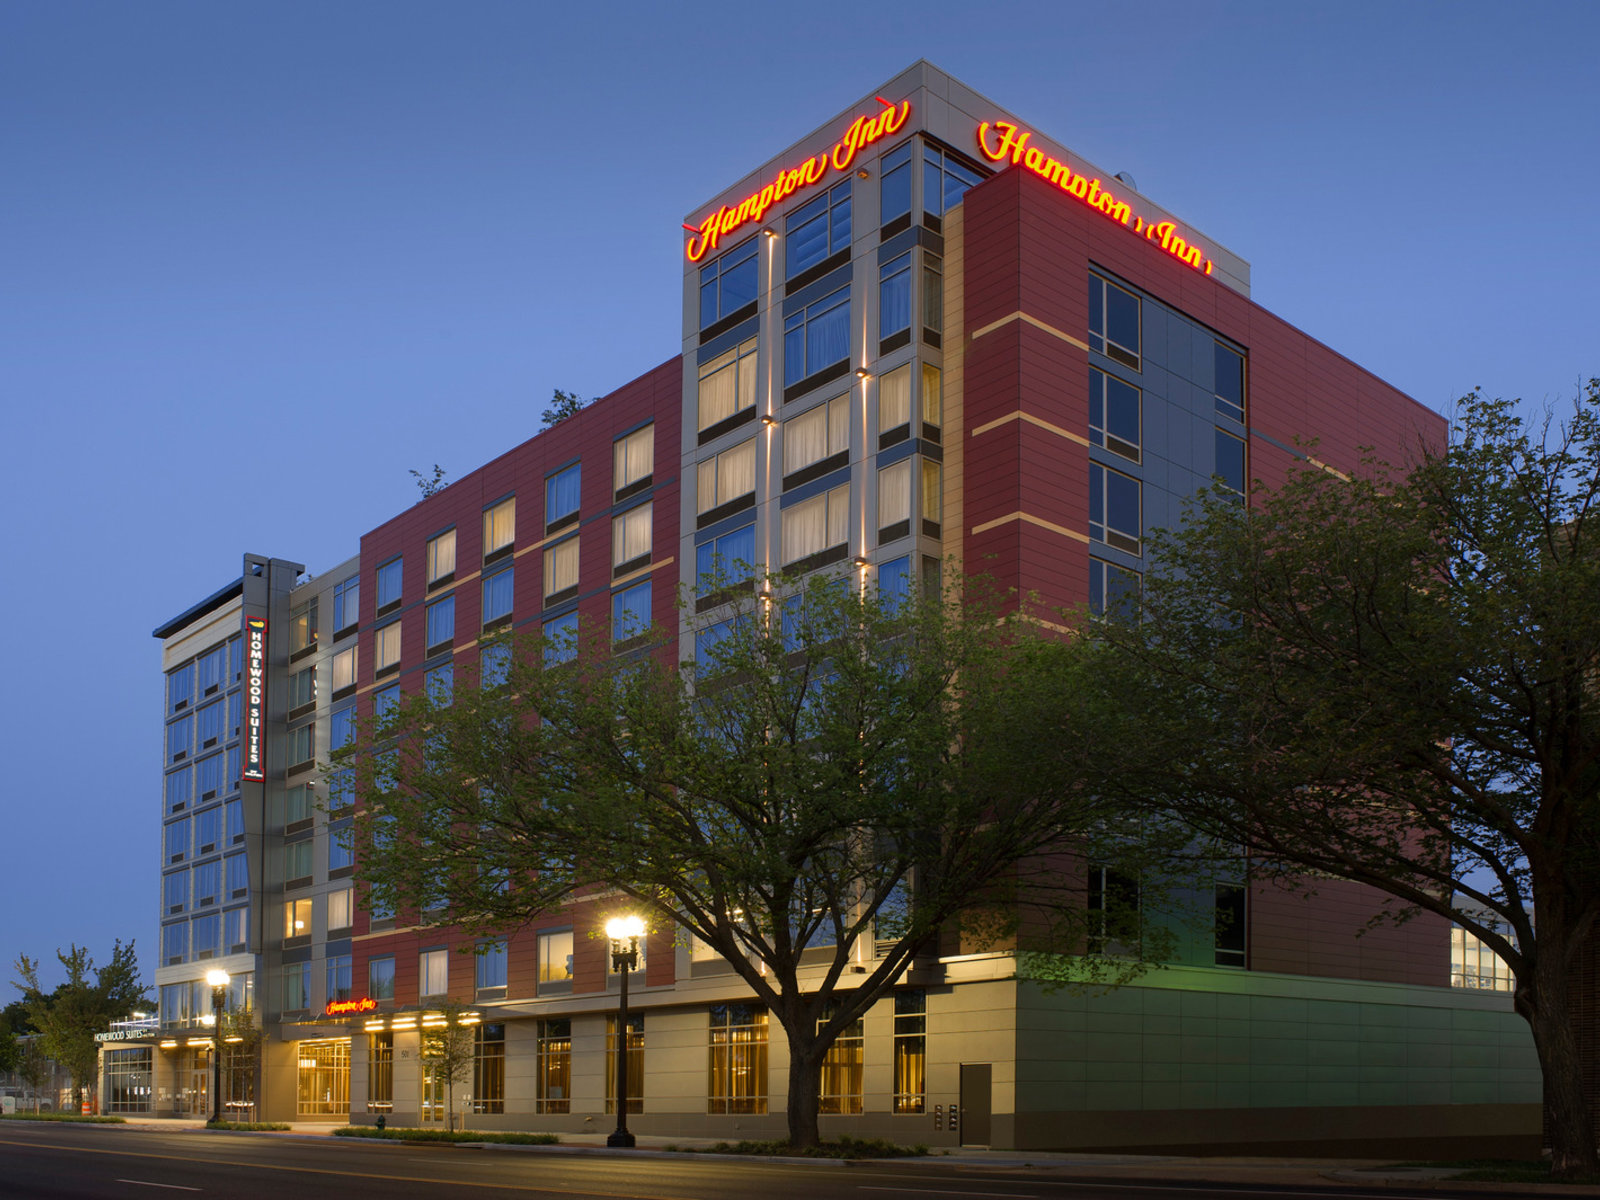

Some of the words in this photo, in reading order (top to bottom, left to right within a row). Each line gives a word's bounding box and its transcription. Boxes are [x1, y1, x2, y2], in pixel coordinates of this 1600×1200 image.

[685, 152, 829, 262] Hampton
[831, 99, 912, 171] Inn
[976, 120, 1143, 233] Hampton
[1145, 221, 1213, 276] Inn
[249, 631, 262, 705] HOMEWOOD
[249, 708, 260, 763] SUITES
[93, 1031, 125, 1042] HOMEWOOD
[125, 1029, 143, 1040] SUITES
[326, 1001, 359, 1015] Hampton
